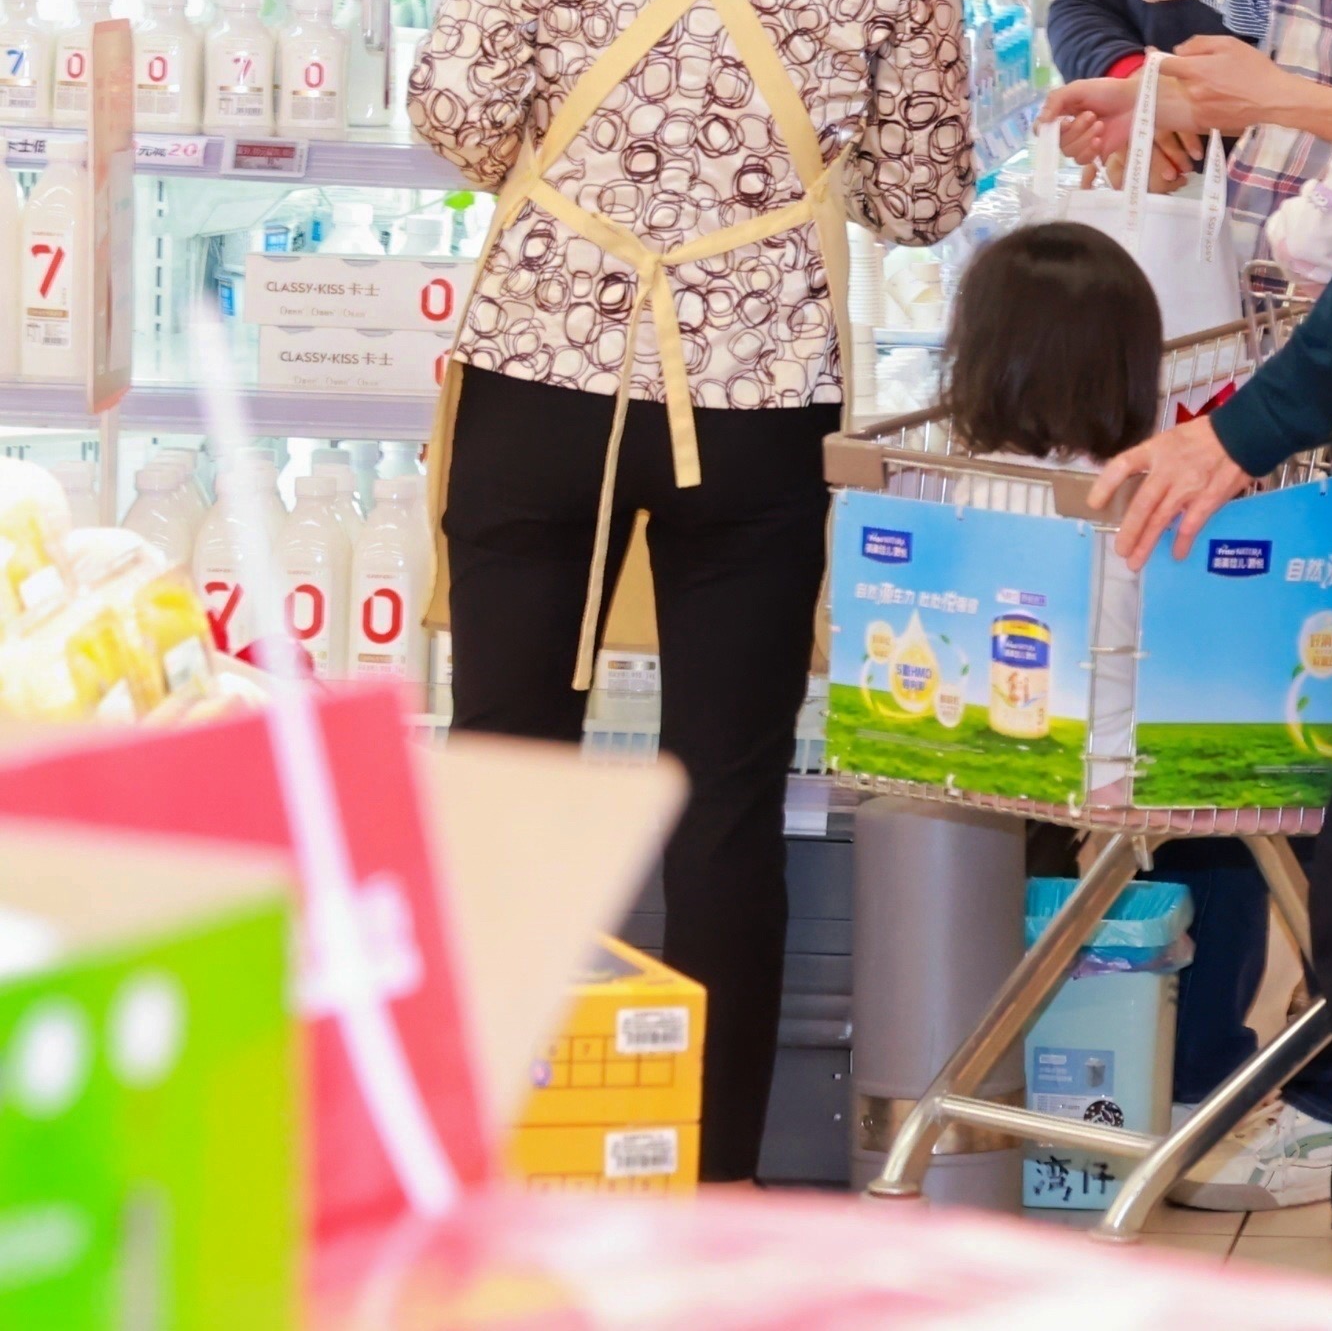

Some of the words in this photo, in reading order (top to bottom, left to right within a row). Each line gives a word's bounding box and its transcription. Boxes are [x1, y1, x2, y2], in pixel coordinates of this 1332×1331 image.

[31, 244, 65, 299] 7
[348, 282, 380, 297] 卡士
[421, 278, 454, 321] 0
[362, 352, 394, 366] 卡士
[362, 587, 403, 644] 0
[1033, 1155, 1116, 1202] 湾仔
